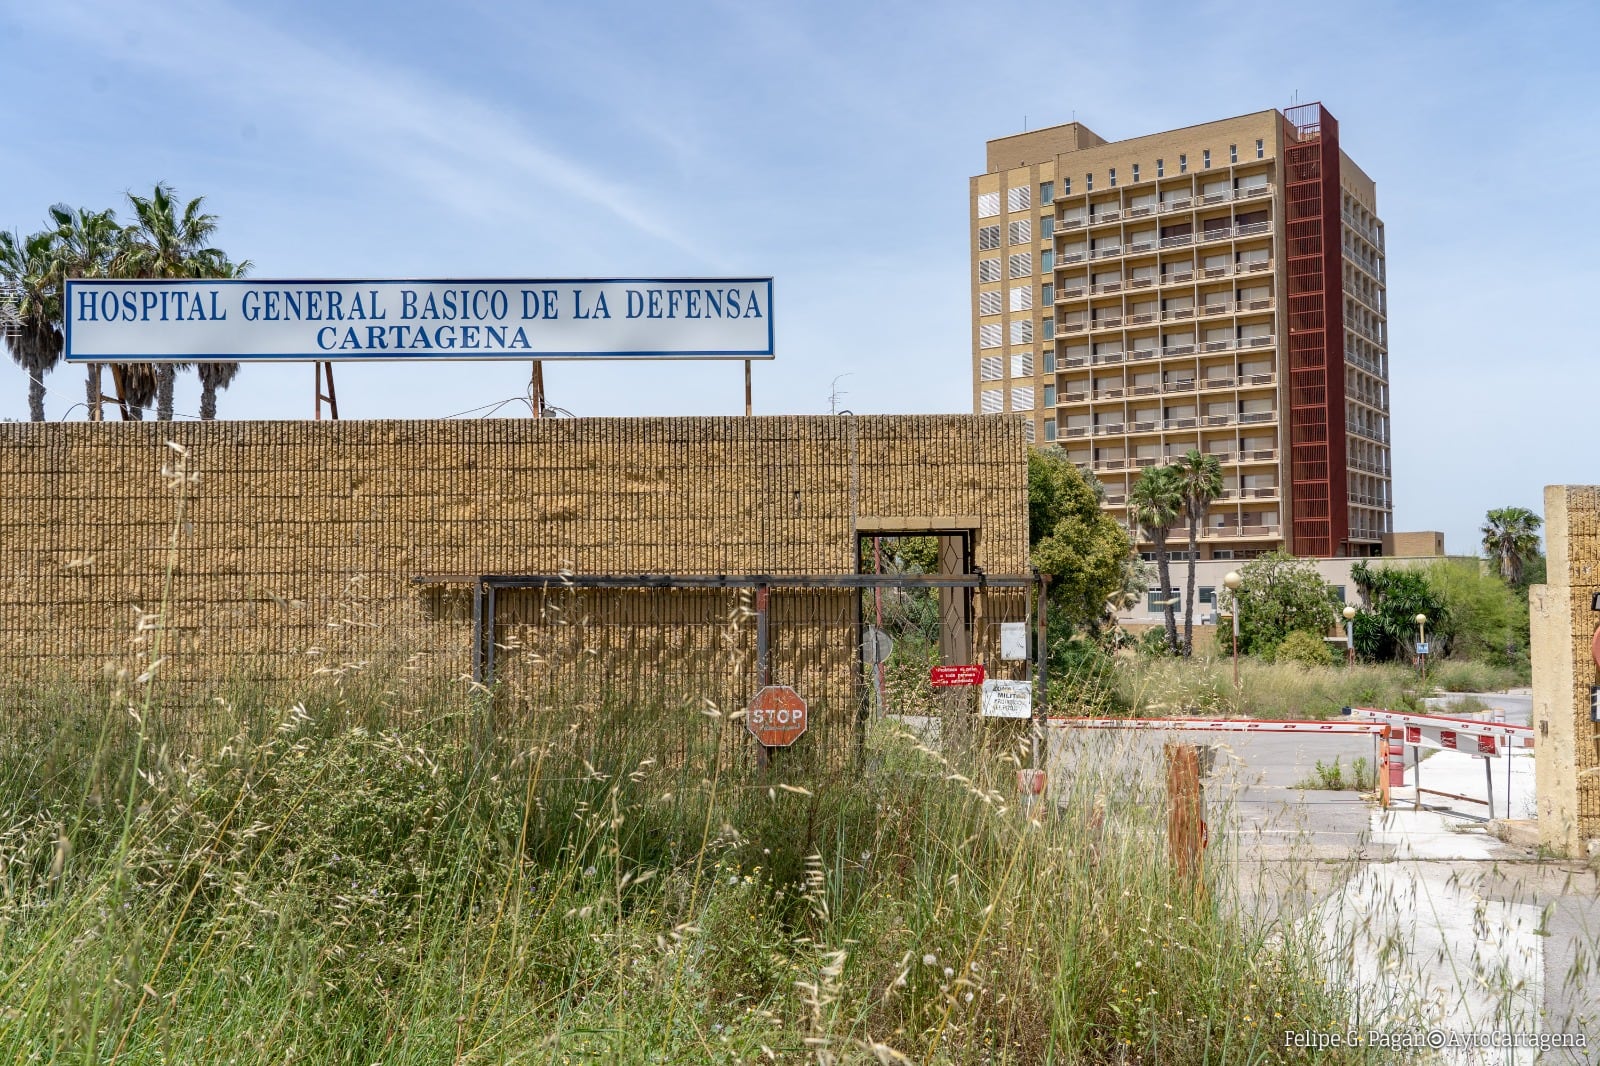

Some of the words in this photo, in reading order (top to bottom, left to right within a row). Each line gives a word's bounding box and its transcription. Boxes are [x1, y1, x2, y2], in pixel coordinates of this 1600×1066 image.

[78, 290, 227, 322] HOSPITAL
[241, 290, 386, 322] GENERAL
[400, 289, 508, 321] BASICO
[521, 289, 559, 320] DE
[572, 289, 612, 320] LA
[625, 288, 763, 319] DEFENSA
[316, 325, 532, 351] CARTAGENA
[752, 709, 803, 724] STOP
